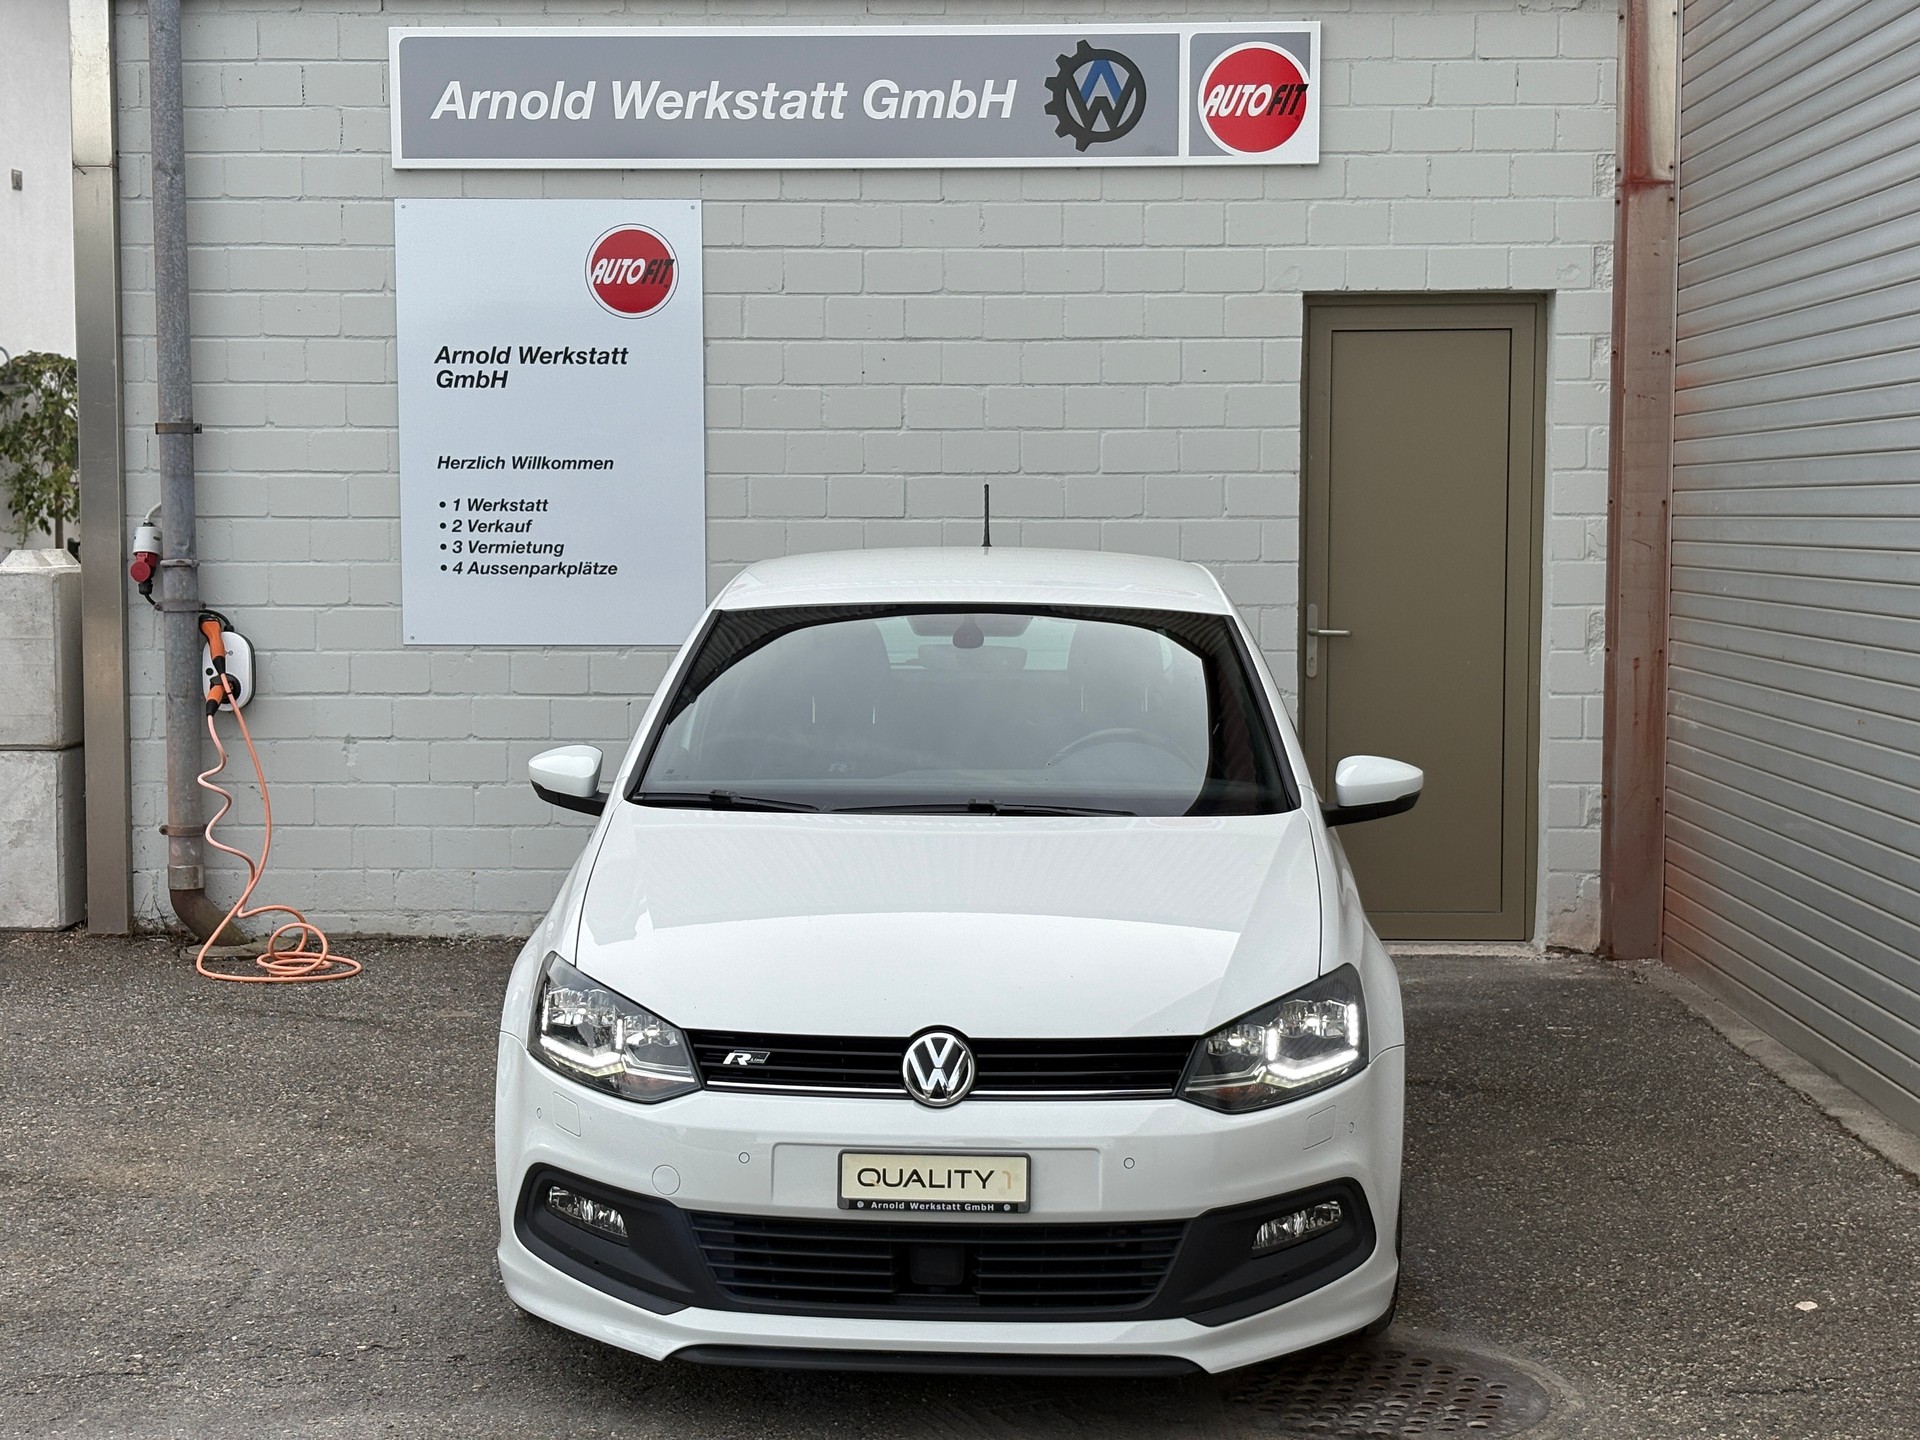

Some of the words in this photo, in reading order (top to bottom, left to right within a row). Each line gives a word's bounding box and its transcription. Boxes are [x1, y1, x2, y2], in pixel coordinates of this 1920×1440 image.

[431, 80, 596, 120] Arnold
[612, 80, 848, 120] Werkstatt
[863, 79, 1018, 119] GmbH
[1203, 83, 1309, 117] AUTOFIT
[590, 258, 675, 285] AUTOFIT
[434, 346, 511, 365] Arnold
[518, 346, 629, 365] Werkstatt
[436, 370, 508, 389] GmbH
[437, 456, 506, 470] Herzlich
[511, 456, 614, 470] Willkommen
[453, 498, 461, 512] 1
[467, 498, 549, 512] Werkstatt
[452, 519, 462, 533] 2
[468, 519, 533, 533] Verkauf
[452, 540, 462, 554] 3
[468, 540, 565, 557] Vermietung
[452, 561, 463, 575] 4
[467, 561, 618, 578] Aussenparkplätze
[857, 1167, 995, 1189] QUALITY
[871, 1201, 905, 1210] Arnold
[910, 1202, 961, 1211] Werkstatt
[964, 1203, 995, 1212] GmbH
